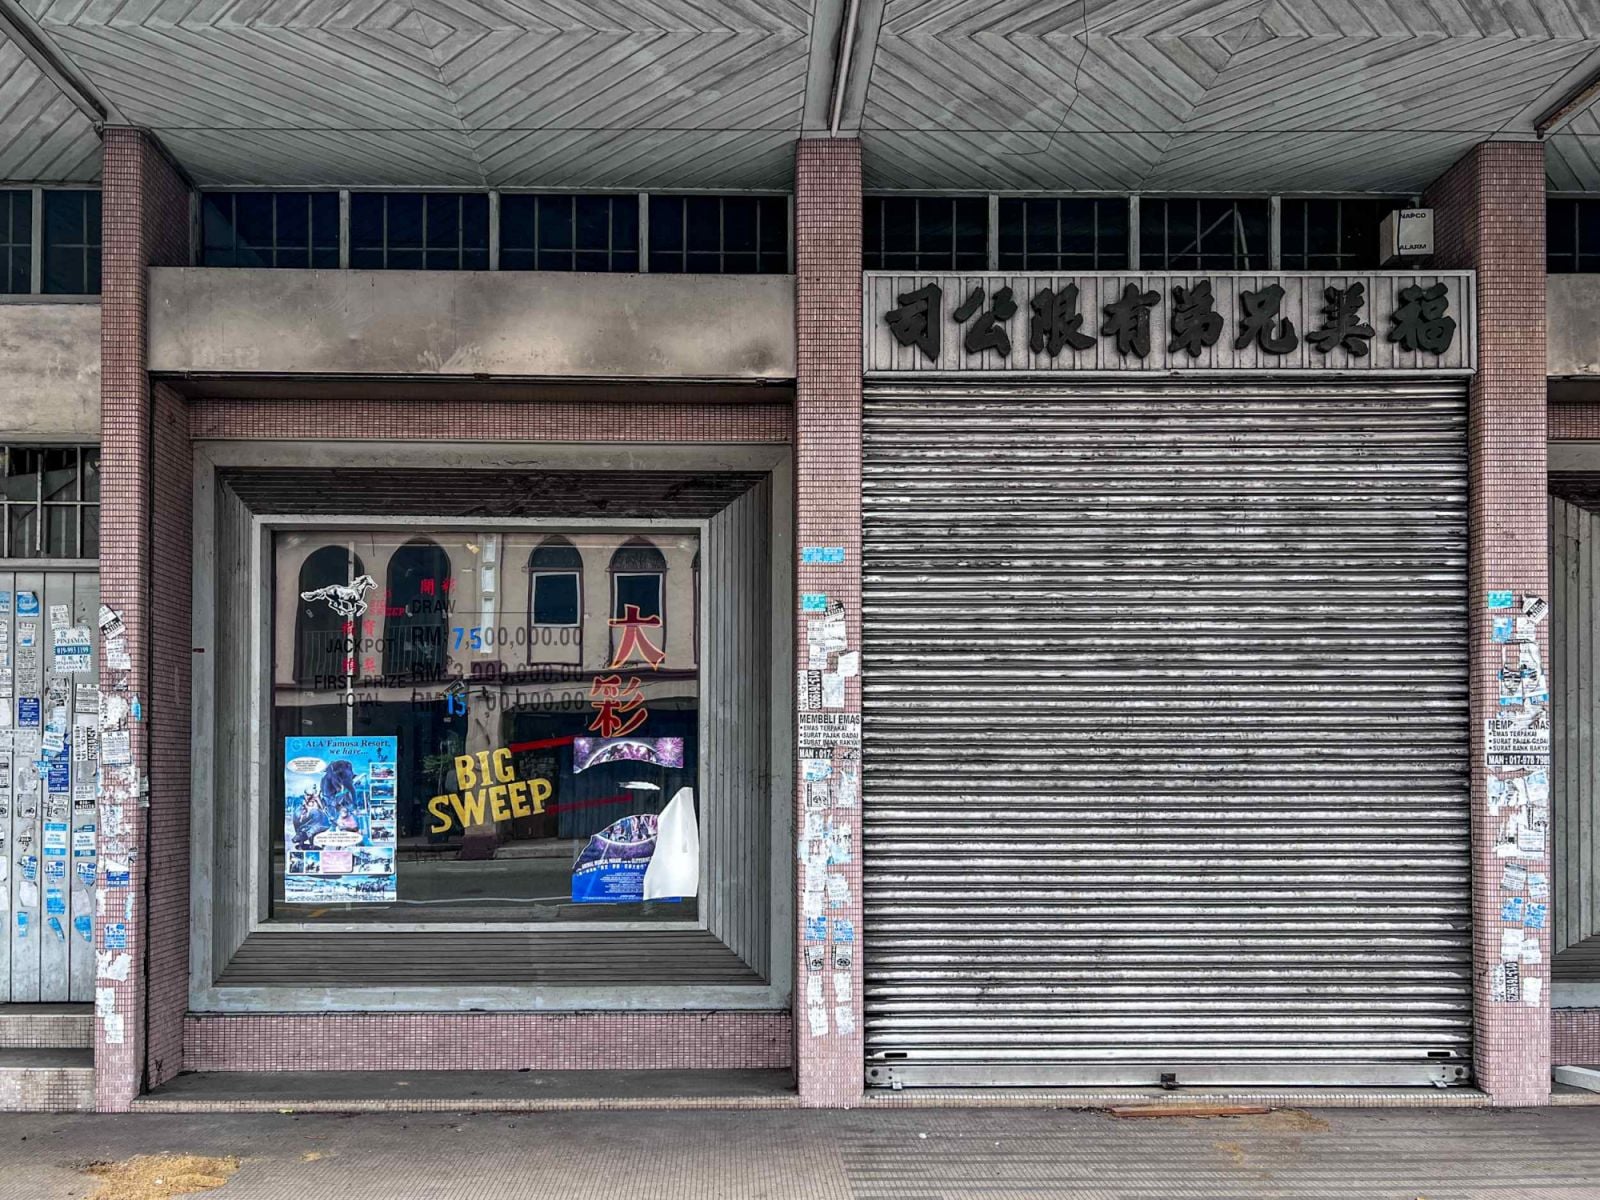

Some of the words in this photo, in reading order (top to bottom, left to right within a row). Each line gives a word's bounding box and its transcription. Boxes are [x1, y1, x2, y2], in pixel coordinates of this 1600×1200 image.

[412, 600, 456, 613] DRAW
[326, 638, 396, 653] JACKPOT
[314, 674, 357, 689] FIRST
[364, 674, 406, 688] PRIZE
[336, 692, 382, 707] TOTAL
[800, 714, 836, 724] MEMBELI
[838, 714, 860, 725] EMAS
[1488, 755, 1504, 764] MAN
[454, 747, 515, 791] BIG
[427, 778, 553, 834] SWEEP
